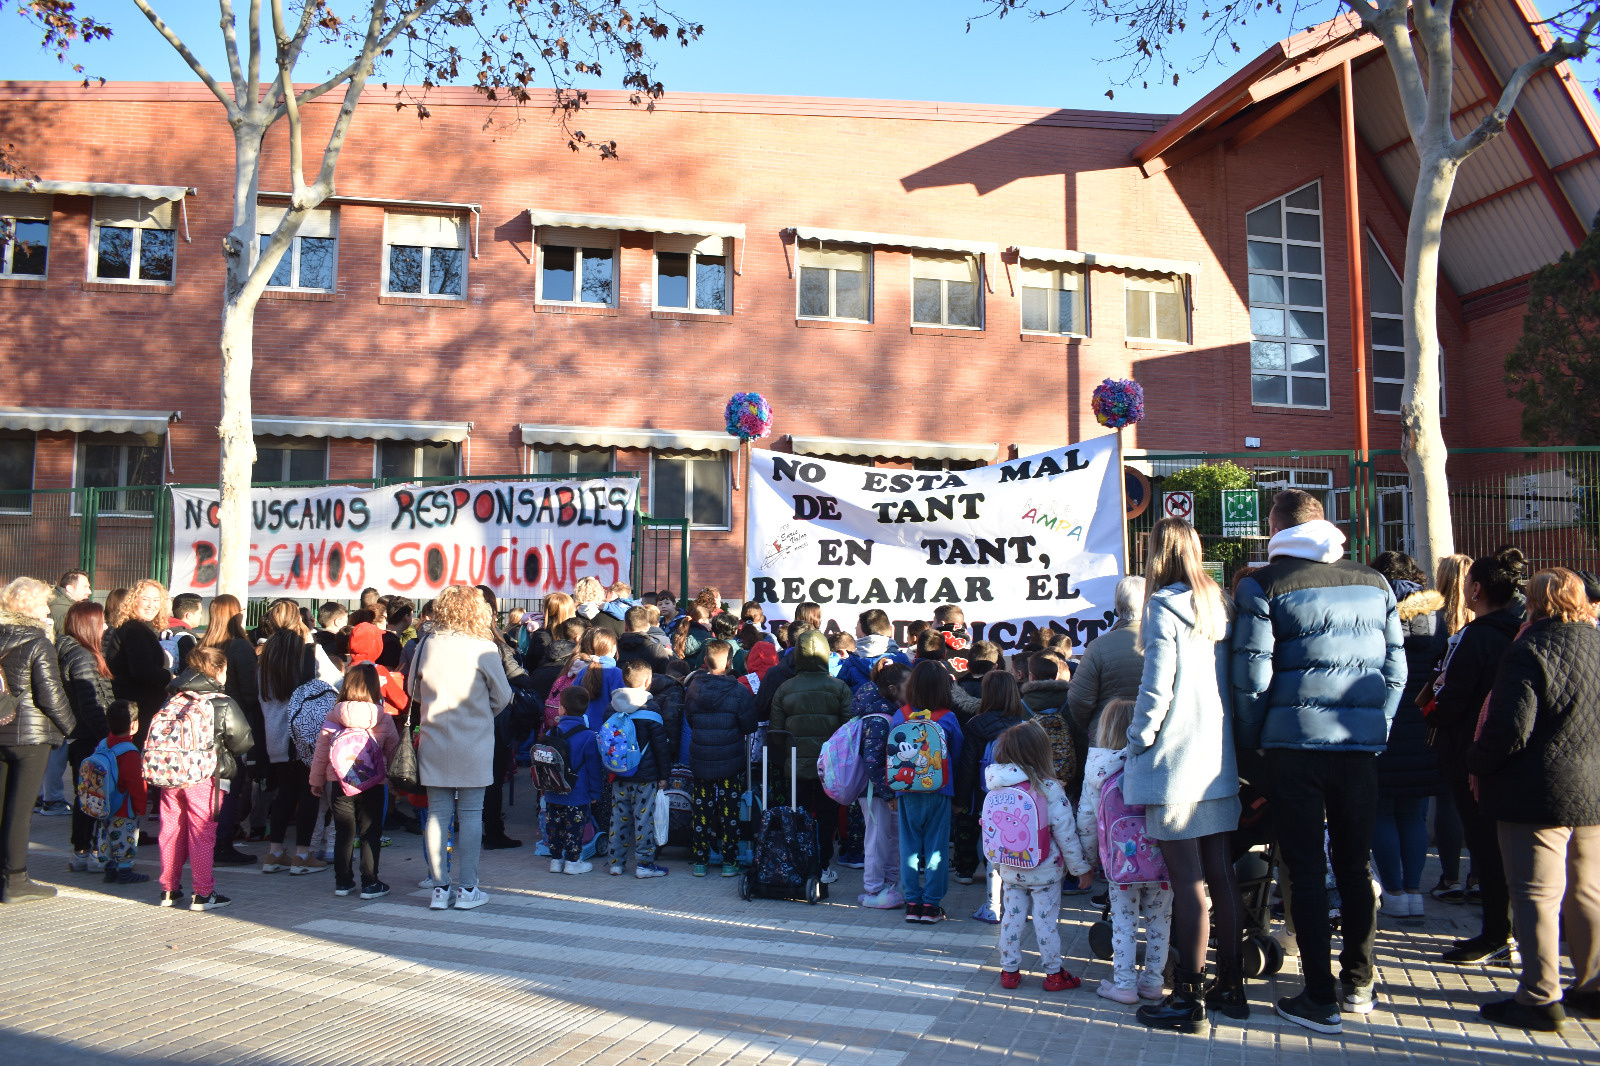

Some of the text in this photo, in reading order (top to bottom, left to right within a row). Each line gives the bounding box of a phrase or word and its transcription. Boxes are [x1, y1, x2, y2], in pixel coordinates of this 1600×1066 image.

[771, 448, 1090, 493] NO ESTÀ MAL
[252, 497, 370, 534] USCAMOS
[391, 486, 630, 533] RESPONSABLES
[792, 492, 986, 523] DE TANT
[1021, 507, 1083, 542] AMPA
[190, 538, 366, 592] BSCAMOS
[817, 535, 1051, 570] EN TANT,
[752, 573, 1081, 605] RECLAMAR EL
[533, 749, 553, 757] STAR
[534, 755, 554, 764] WARS
[988, 793, 1016, 808] PEPPA
